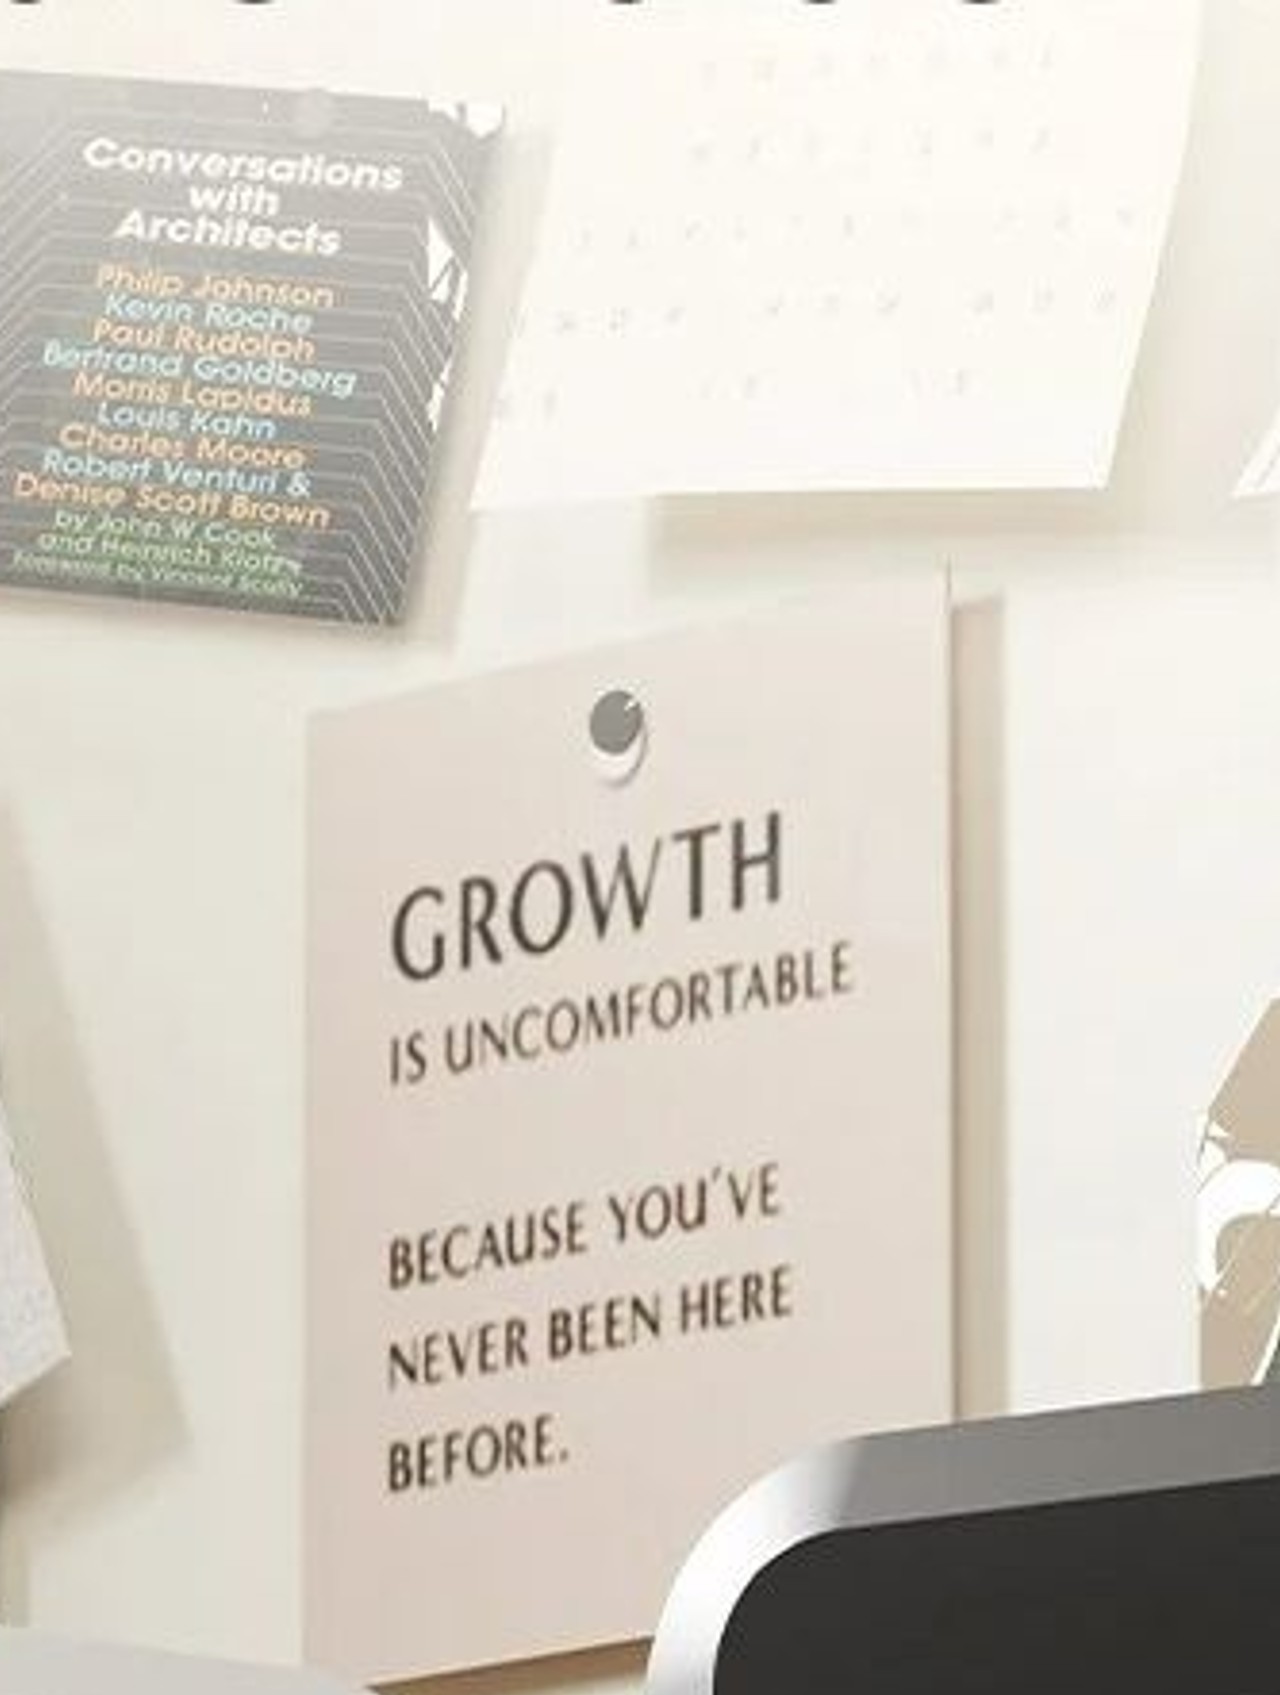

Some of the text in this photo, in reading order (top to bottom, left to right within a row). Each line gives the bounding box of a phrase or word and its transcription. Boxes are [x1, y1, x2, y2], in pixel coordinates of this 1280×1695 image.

[82, 136, 404, 193] Conversations
[188, 181, 280, 217] with
[115, 208, 342, 258] Architects
[96, 265, 335, 308] Philip Johnson
[105, 293, 314, 333] Kevin Roche
[92, 317, 316, 362] Paul Rudolph
[42, 339, 358, 398] Bertrand Goldberg
[73, 370, 312, 417] Morris Lapidus
[97, 401, 277, 440] Louis Kahn
[59, 426, 308, 470] Charles Moore
[41, 450, 312, 498] Robert Venturi &
[13, 471, 332, 528] Denise Scott Brown
[204, 523, 277, 549] Cook
[389, 810, 784, 982] GROWTH
[389, 940, 854, 1087] IS UNCOMFORTABLE
[388, 1161, 782, 1291] BECAUSE YOU'VE
[388, 1264, 793, 1392] NEVER BEEN HERE
[388, 1413, 570, 1494] BEFORE.
